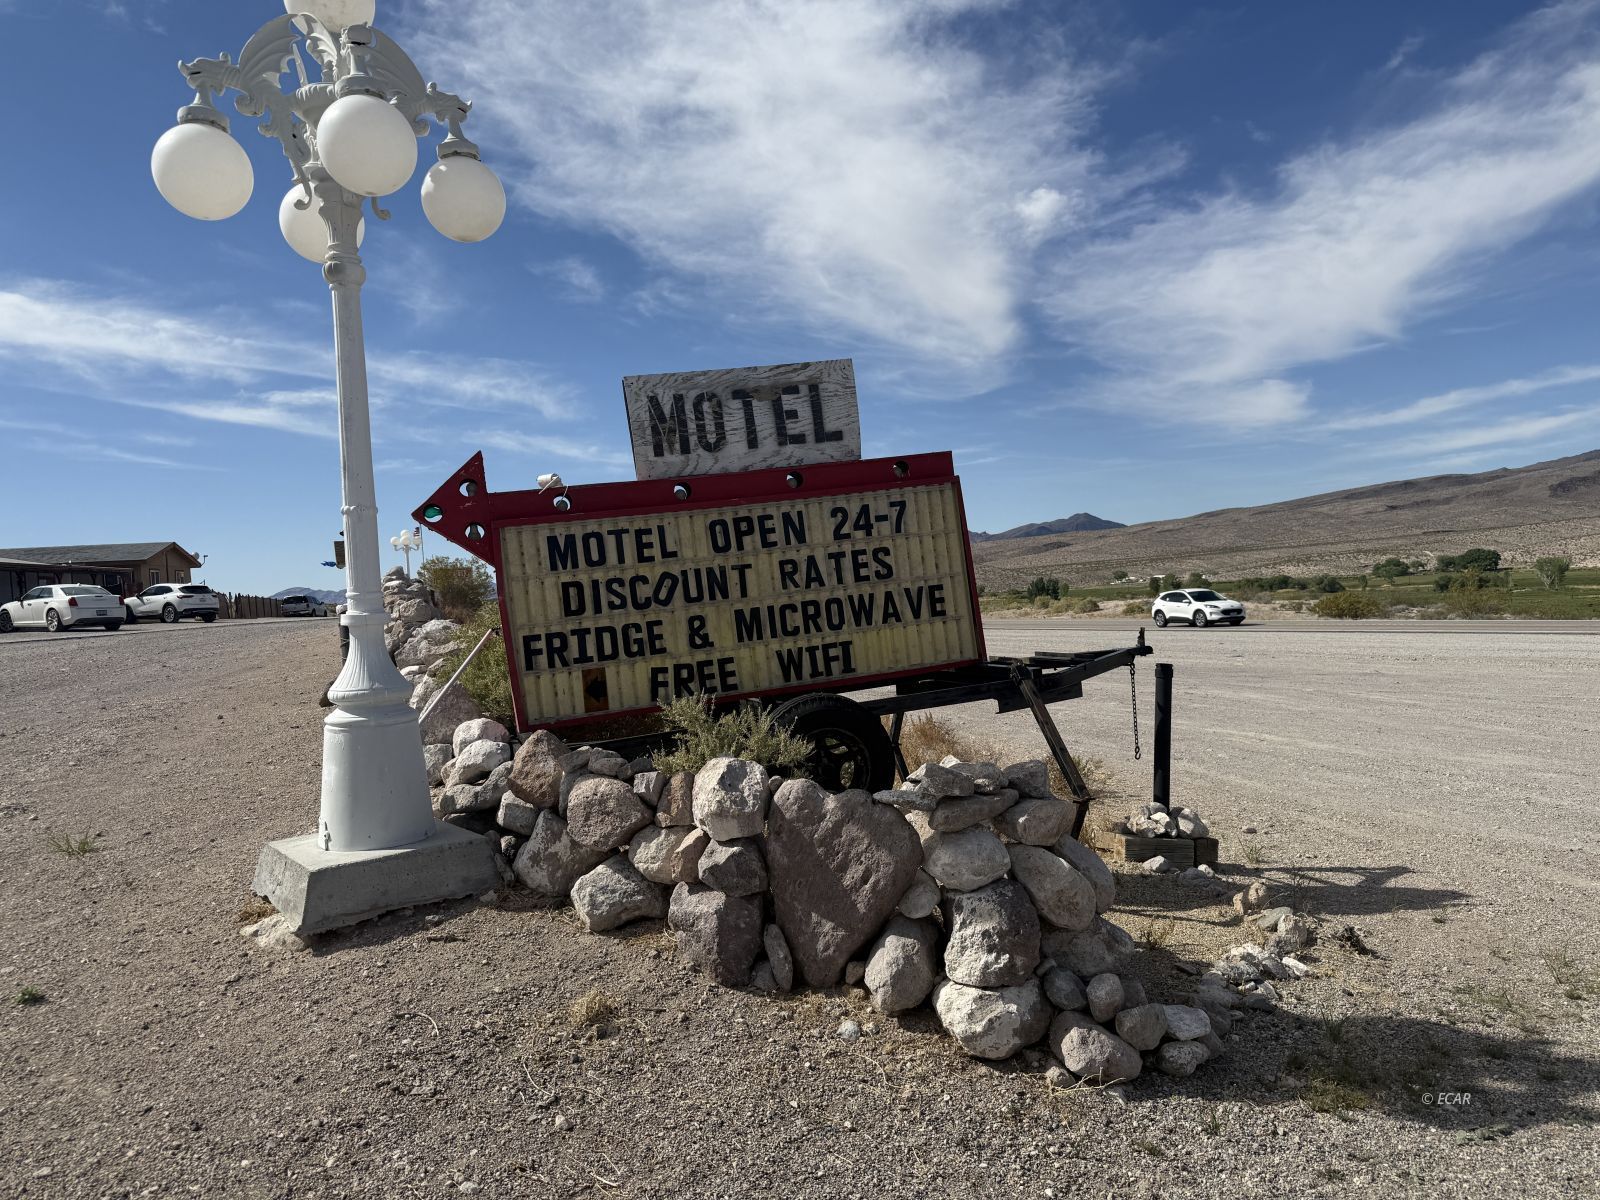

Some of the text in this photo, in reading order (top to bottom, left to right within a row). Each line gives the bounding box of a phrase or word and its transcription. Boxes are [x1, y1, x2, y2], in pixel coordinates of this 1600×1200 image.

[647, 383, 844, 457] MOTEL
[546, 500, 908, 572] MOTEL OPEN 24-7
[561, 546, 894, 618] DISCOUNT RATES
[522, 584, 947, 672] FRIDGE & MICROWAVE
[650, 640, 856, 702] FREE WIFI
